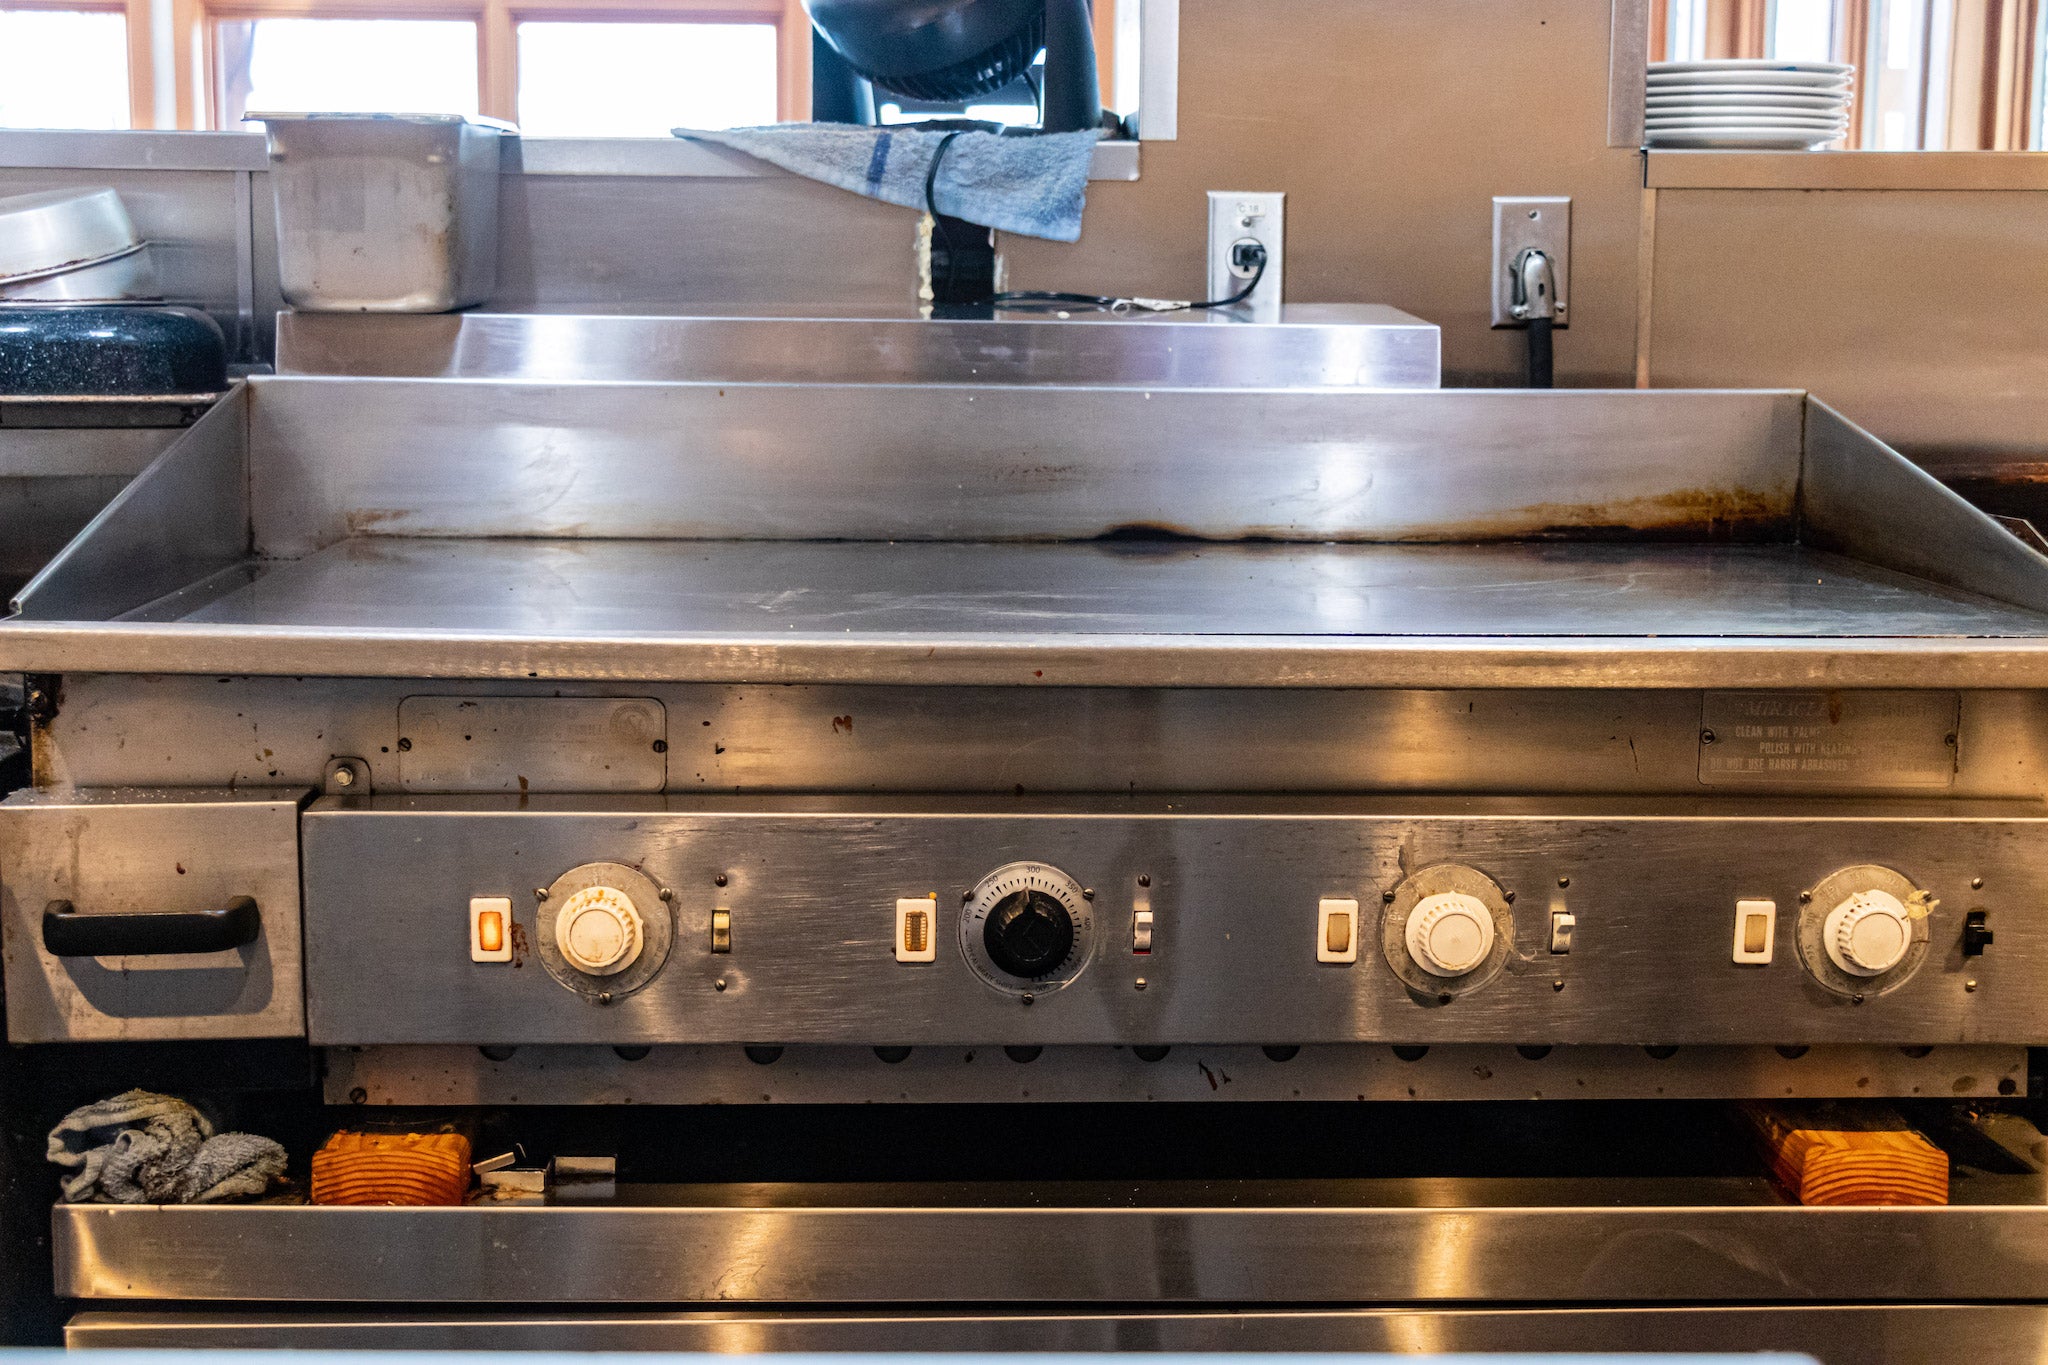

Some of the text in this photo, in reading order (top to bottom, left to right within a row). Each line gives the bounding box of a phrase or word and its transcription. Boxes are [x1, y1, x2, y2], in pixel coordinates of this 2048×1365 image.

[1735, 726, 1763, 738] CLEAN
[1768, 726, 1789, 738] WITH
[1760, 742, 1790, 754] POLISH
[1795, 743, 1816, 754] WITH
[1749, 758, 1764, 769] USE
[1769, 759, 1797, 770] HARSH
[1026, 865, 1041, 874] 300
[985, 875, 999, 888] 250
[1065, 880, 1079, 893] 350
[962, 908, 973, 923] 200
[1084, 916, 1092, 931] 400
